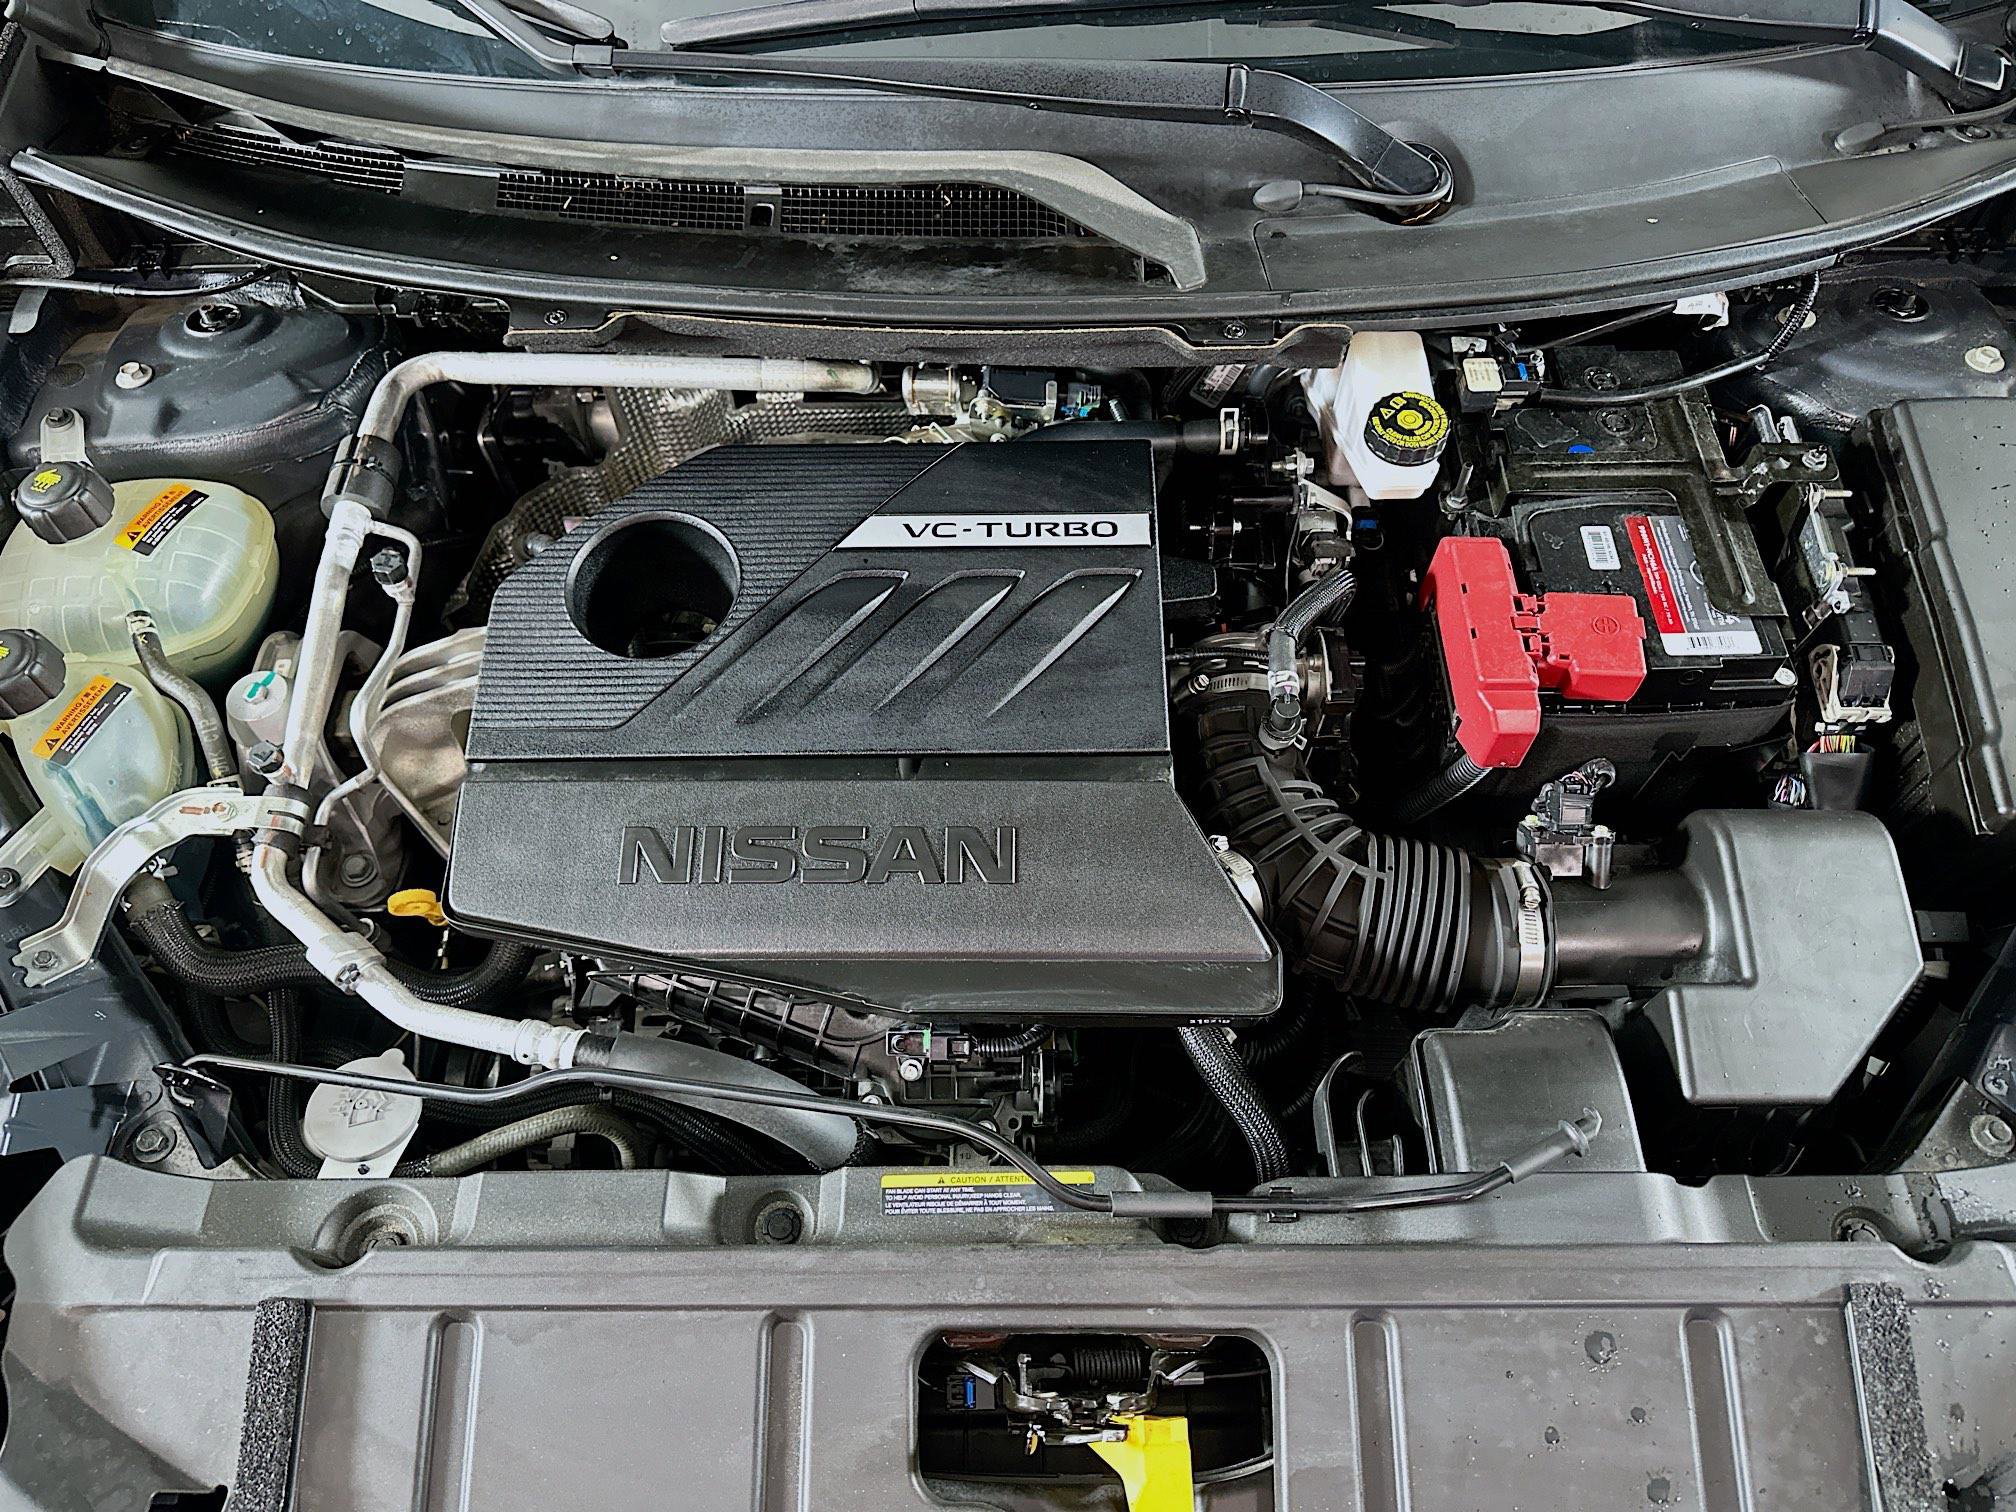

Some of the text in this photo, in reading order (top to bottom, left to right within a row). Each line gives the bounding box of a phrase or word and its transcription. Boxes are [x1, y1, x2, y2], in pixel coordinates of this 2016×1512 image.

[902, 521, 1118, 538] VC-TURBO
[54, 703, 82, 732] WARNING
[62, 684, 107, 735] AVERTISSEMENT
[617, 826, 1017, 885] NISSAN
